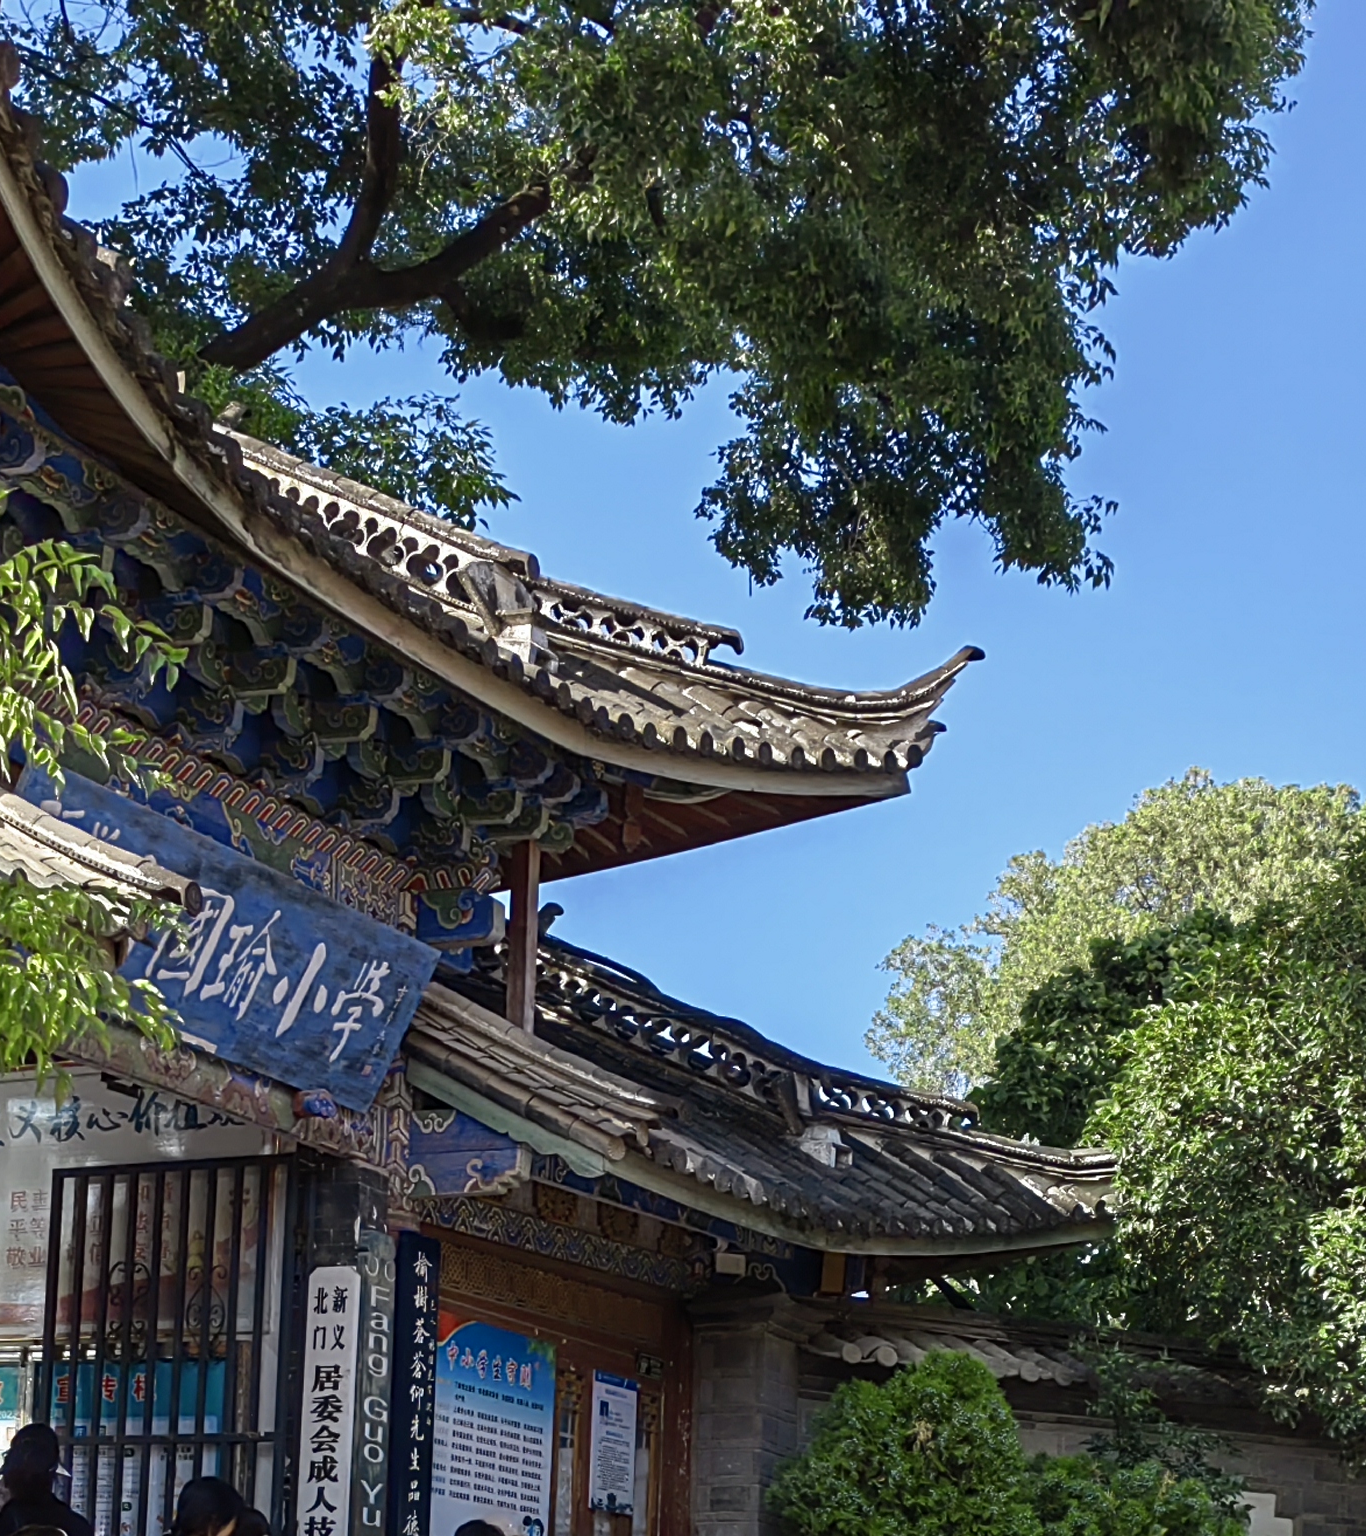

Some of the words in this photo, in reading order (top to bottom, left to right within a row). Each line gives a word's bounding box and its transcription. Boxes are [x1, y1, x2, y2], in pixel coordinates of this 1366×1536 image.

[8, 1218, 46, 1241] 平等
[6, 1245, 46, 1269] 敬业
[367, 1286, 390, 1377] Fang
[446, 1340, 533, 1391] 中小学生守则
[363, 1396, 388, 1464] Guo
[361, 1480, 384, 1527] Yu
